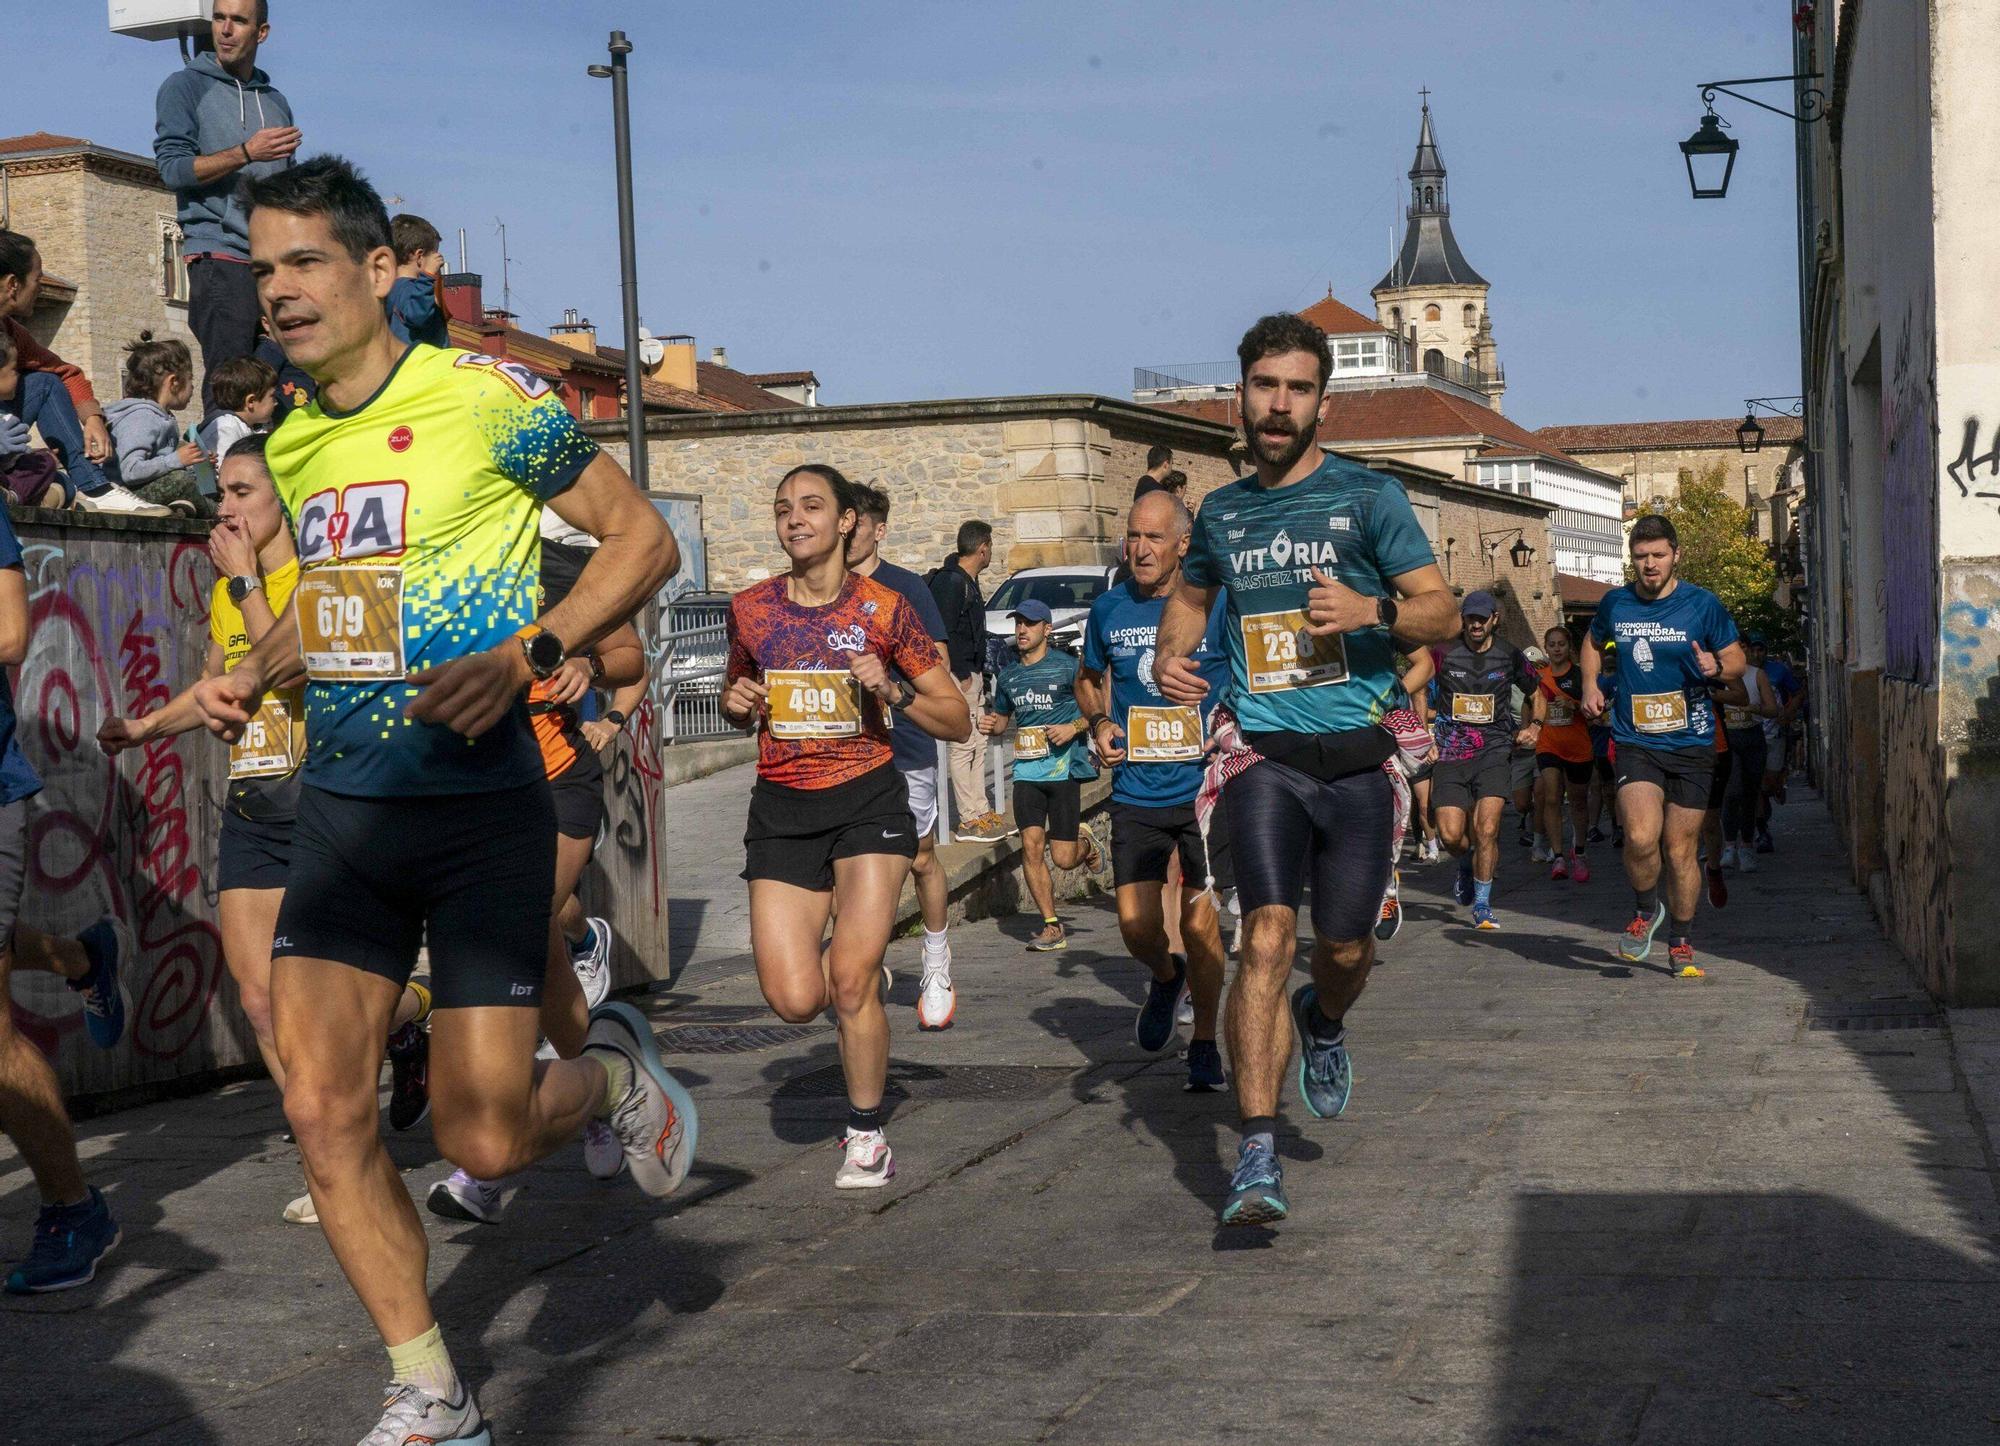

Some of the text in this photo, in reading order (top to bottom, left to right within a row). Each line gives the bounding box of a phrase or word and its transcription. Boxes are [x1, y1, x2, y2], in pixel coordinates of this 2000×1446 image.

[1227, 528, 1246, 541] Vital
[377, 577, 395, 589] 10K
[1232, 566, 1338, 591] GASTEIZ TRIL
[317, 595, 364, 637] 679
[1110, 626, 1158, 639] LA CONQUI
[1622, 628, 1675, 636] ALMENDRA
[1124, 635, 1156, 647] ALME
[1263, 629, 1315, 663] 238
[788, 688, 836, 714] 499
[1645, 702, 1673, 718] 626
[1145, 720, 1184, 741] 689
